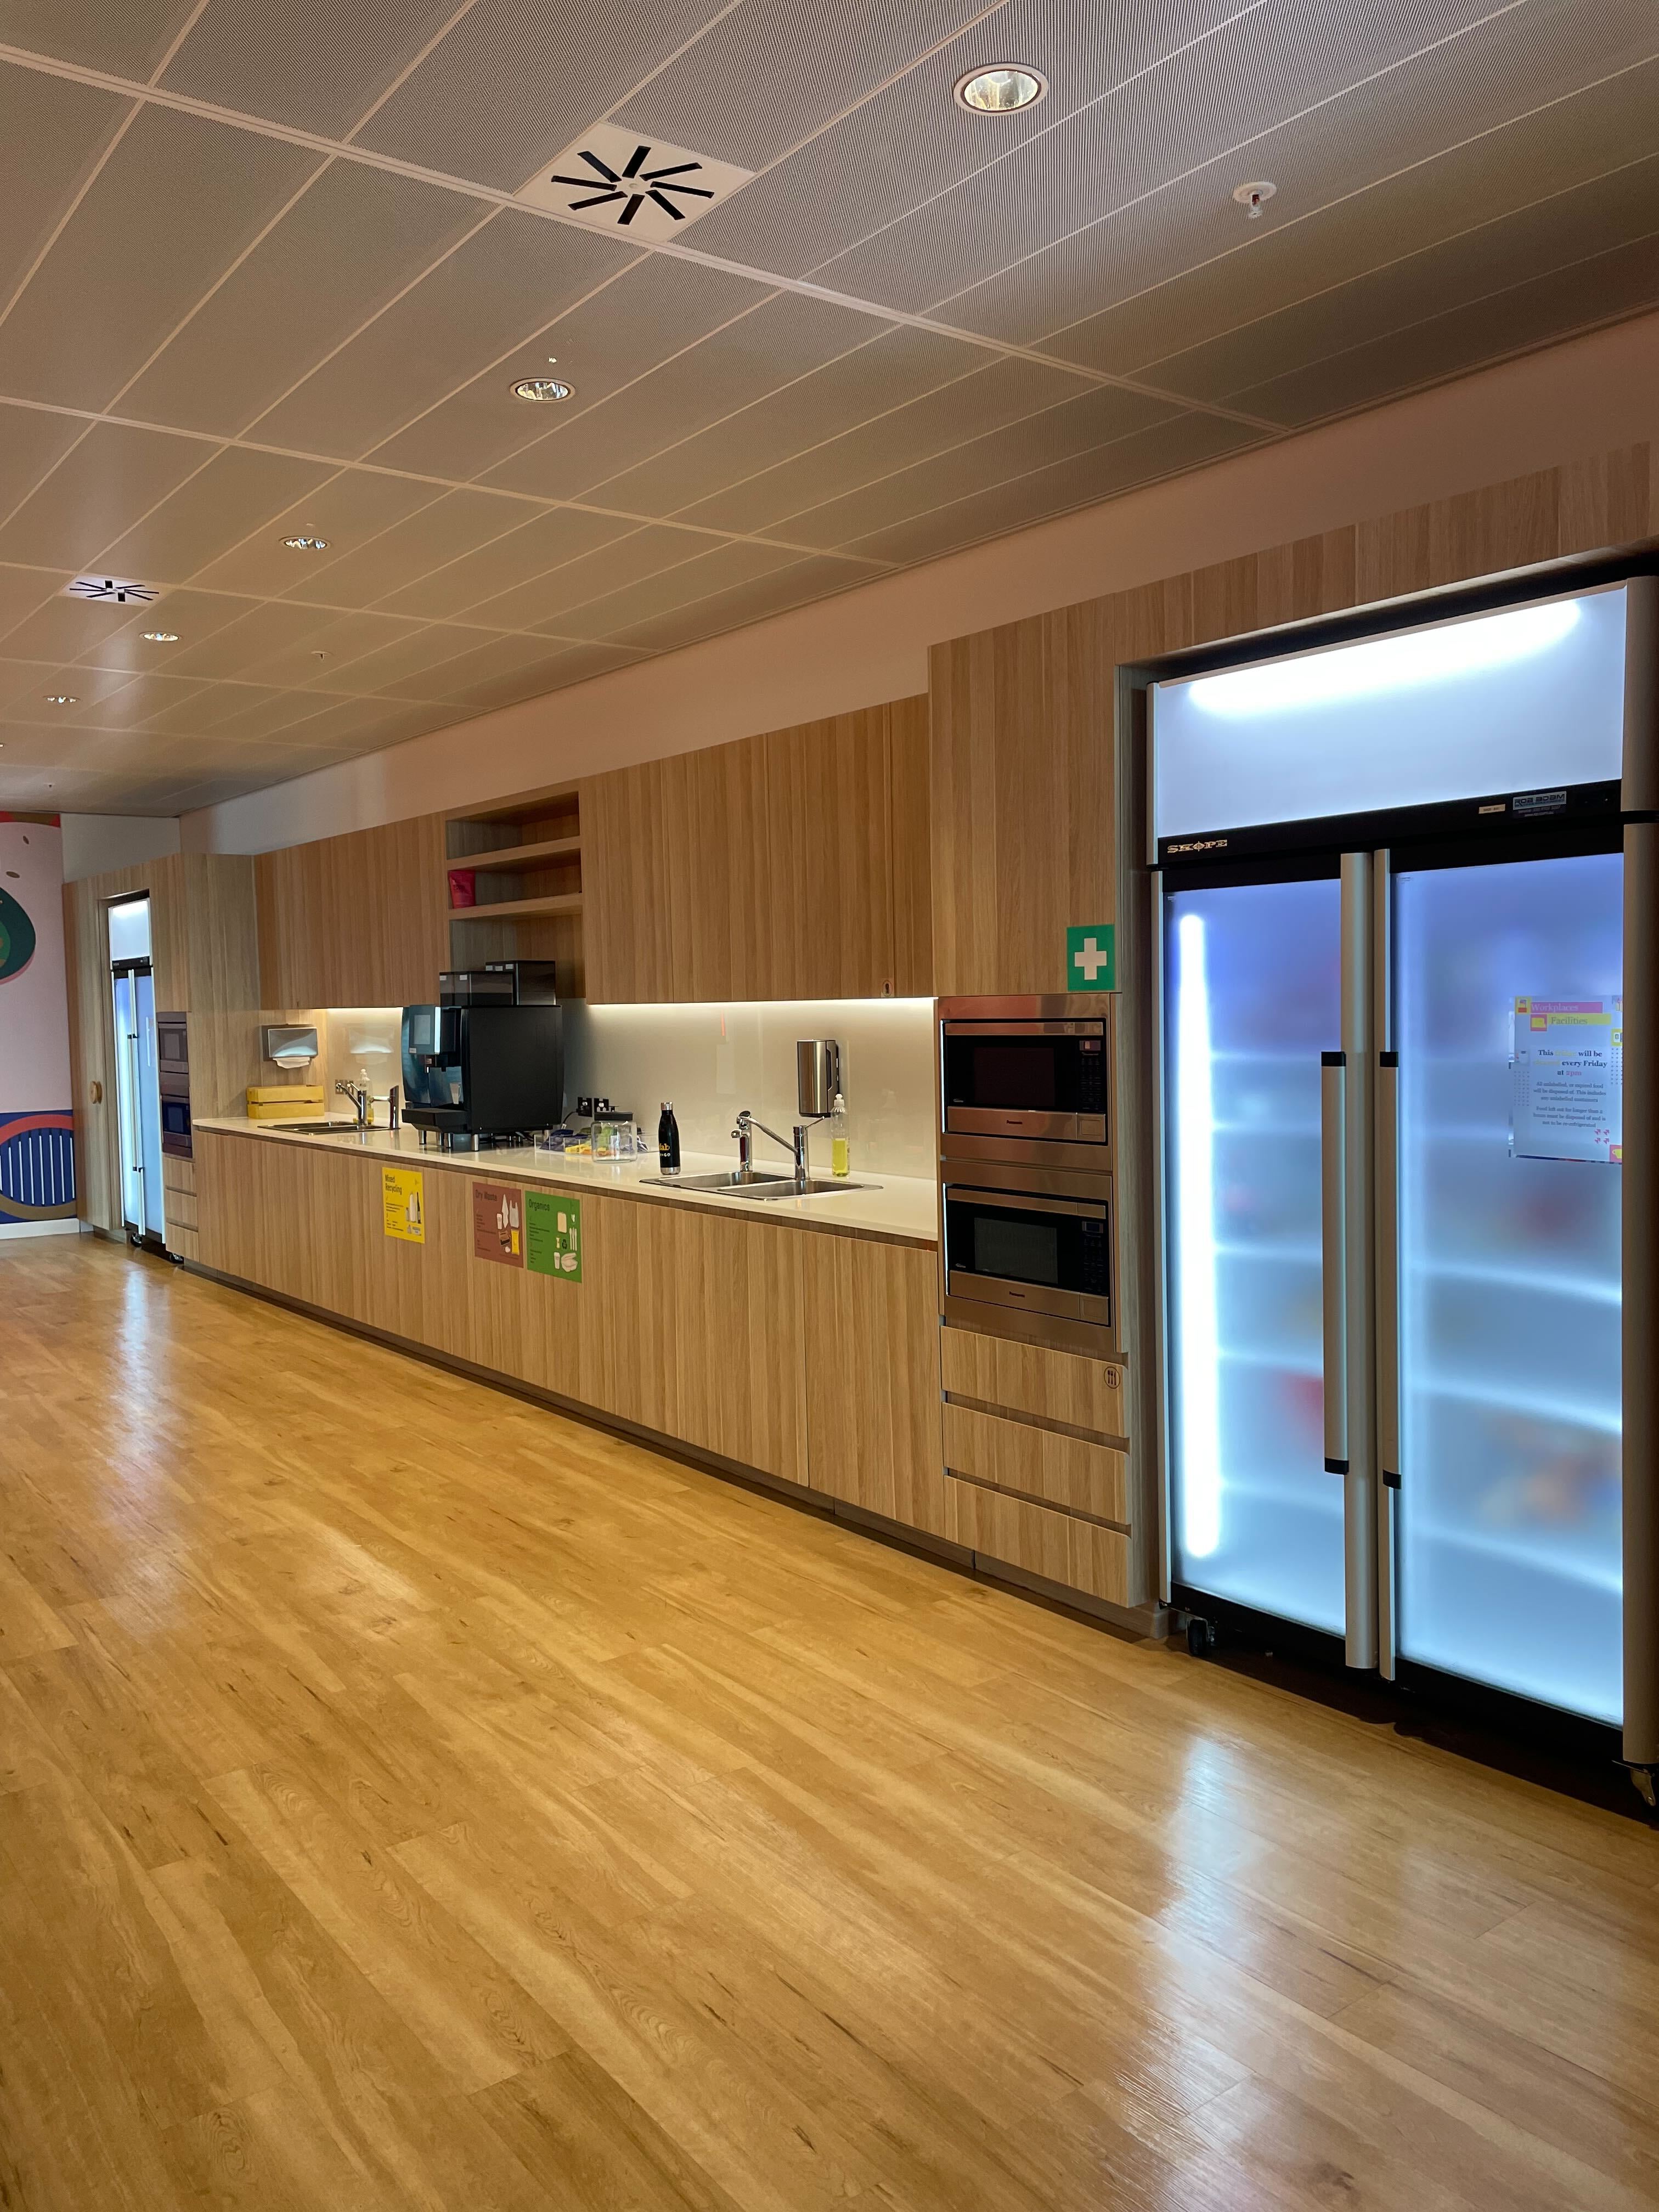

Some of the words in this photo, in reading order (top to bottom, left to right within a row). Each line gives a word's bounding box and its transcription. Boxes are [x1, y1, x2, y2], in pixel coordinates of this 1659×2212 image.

[1167, 839, 1228, 853] SKOPE
[1531, 1003, 1579, 1013] Workplaces
[1551, 1017, 1588, 1025] Facilities
[385, 1183, 402, 1195] Recycling
[528, 1199, 550, 1211] Organics
